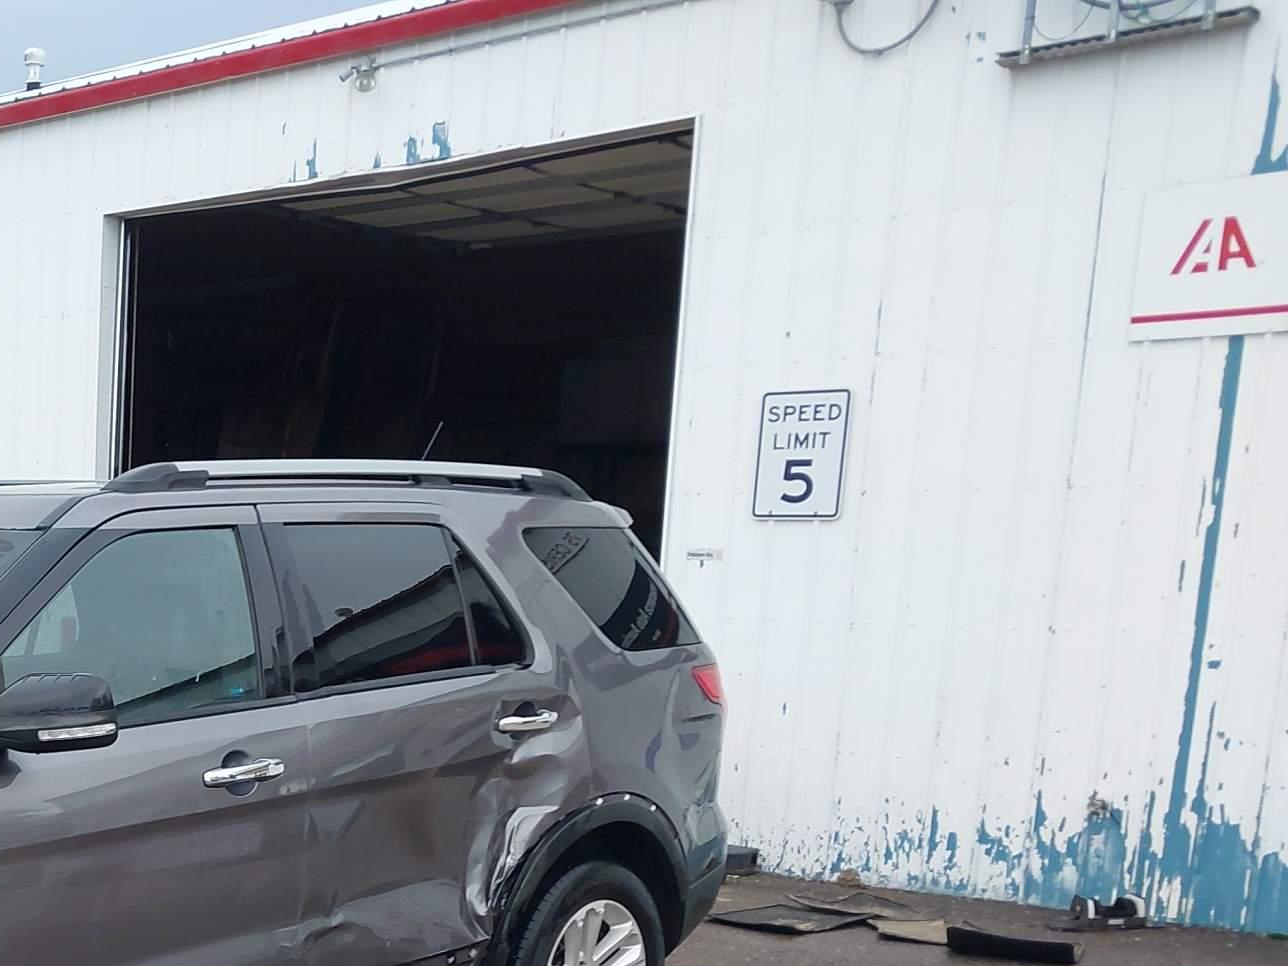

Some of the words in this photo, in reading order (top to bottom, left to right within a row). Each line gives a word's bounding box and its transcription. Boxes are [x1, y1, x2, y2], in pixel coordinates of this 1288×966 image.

[768, 403, 842, 422] SPEED
[773, 431, 832, 450] LIMIT
[780, 459, 814, 503] 5
